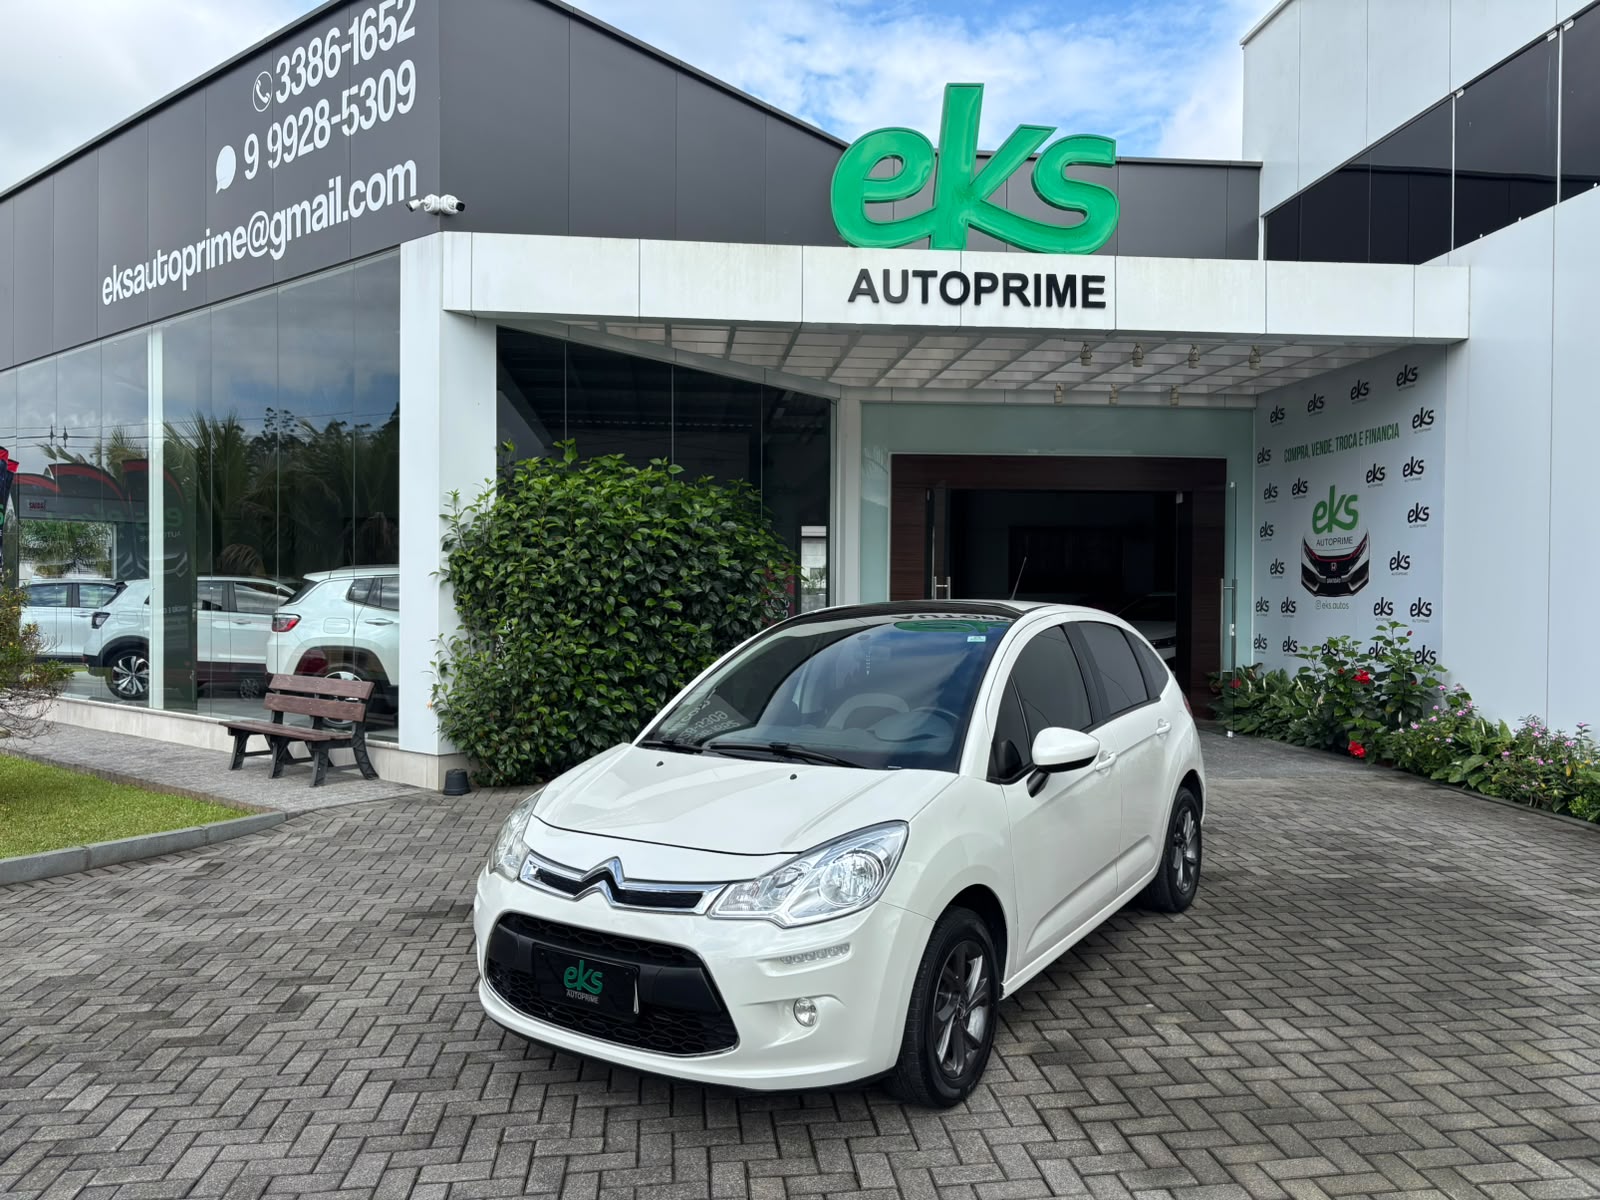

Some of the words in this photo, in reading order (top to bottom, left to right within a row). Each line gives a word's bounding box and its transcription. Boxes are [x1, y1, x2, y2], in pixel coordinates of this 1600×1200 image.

[276, 0, 416, 103] 3386-1652
[244, 133, 259, 180] 9
[267, 59, 416, 169] 9928-5309
[830, 82, 1120, 255] eks
[102, 160, 417, 305] eksautoprime@gmail.com
[848, 268, 1106, 309] AUTOPRIME
[1335, 432, 1357, 451] TROCA
[1358, 431, 1364, 447] E
[1364, 422, 1400, 446] FINANCIA
[1312, 484, 1359, 535] eks
[1316, 536, 1353, 547] AUTOPRIME
[563, 959, 604, 995] eks
[566, 988, 600, 1004] AUTOPRIME
